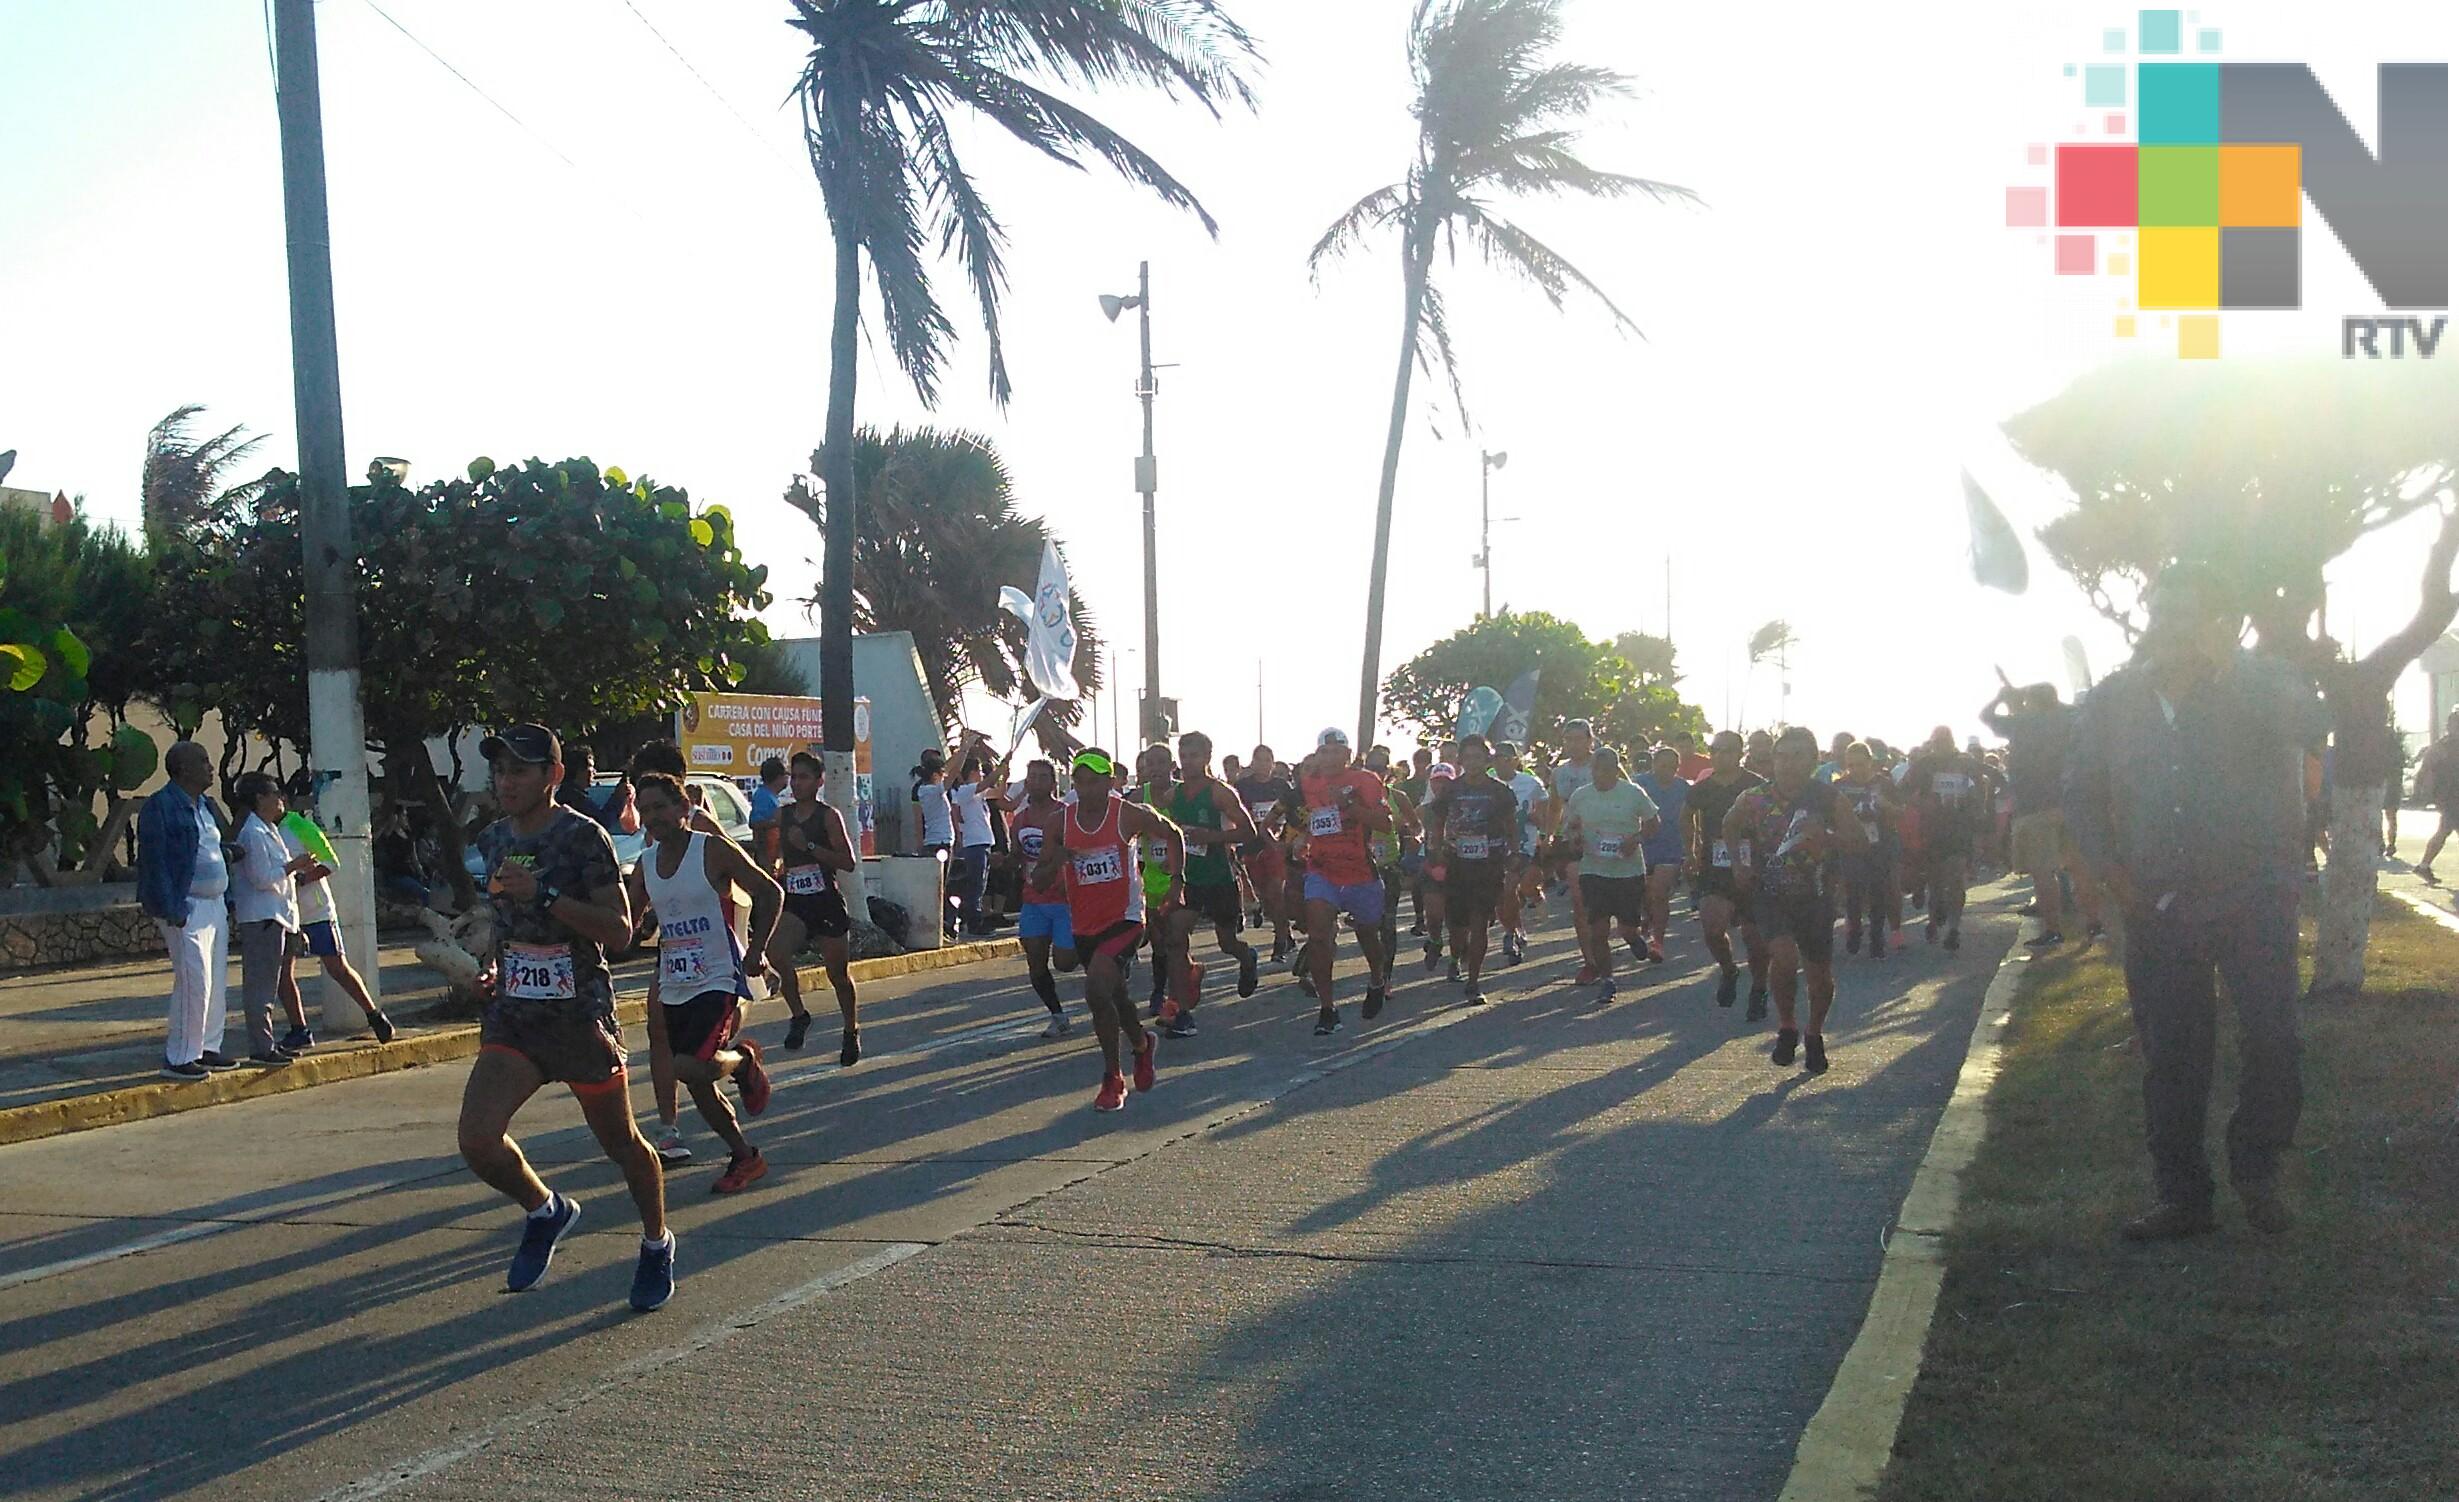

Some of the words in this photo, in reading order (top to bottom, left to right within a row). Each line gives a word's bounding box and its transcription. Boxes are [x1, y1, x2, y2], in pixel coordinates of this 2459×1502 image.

[708, 704, 749, 720] CARRERA
[751, 706, 771, 720] CON
[772, 707, 800, 721] CAUSA
[728, 722, 752, 737] CASA
[754, 723, 770, 737] DEL
[772, 721, 795, 738] NIÑO
[1086, 861, 1109, 877] 031
[521, 966, 551, 987] 218
